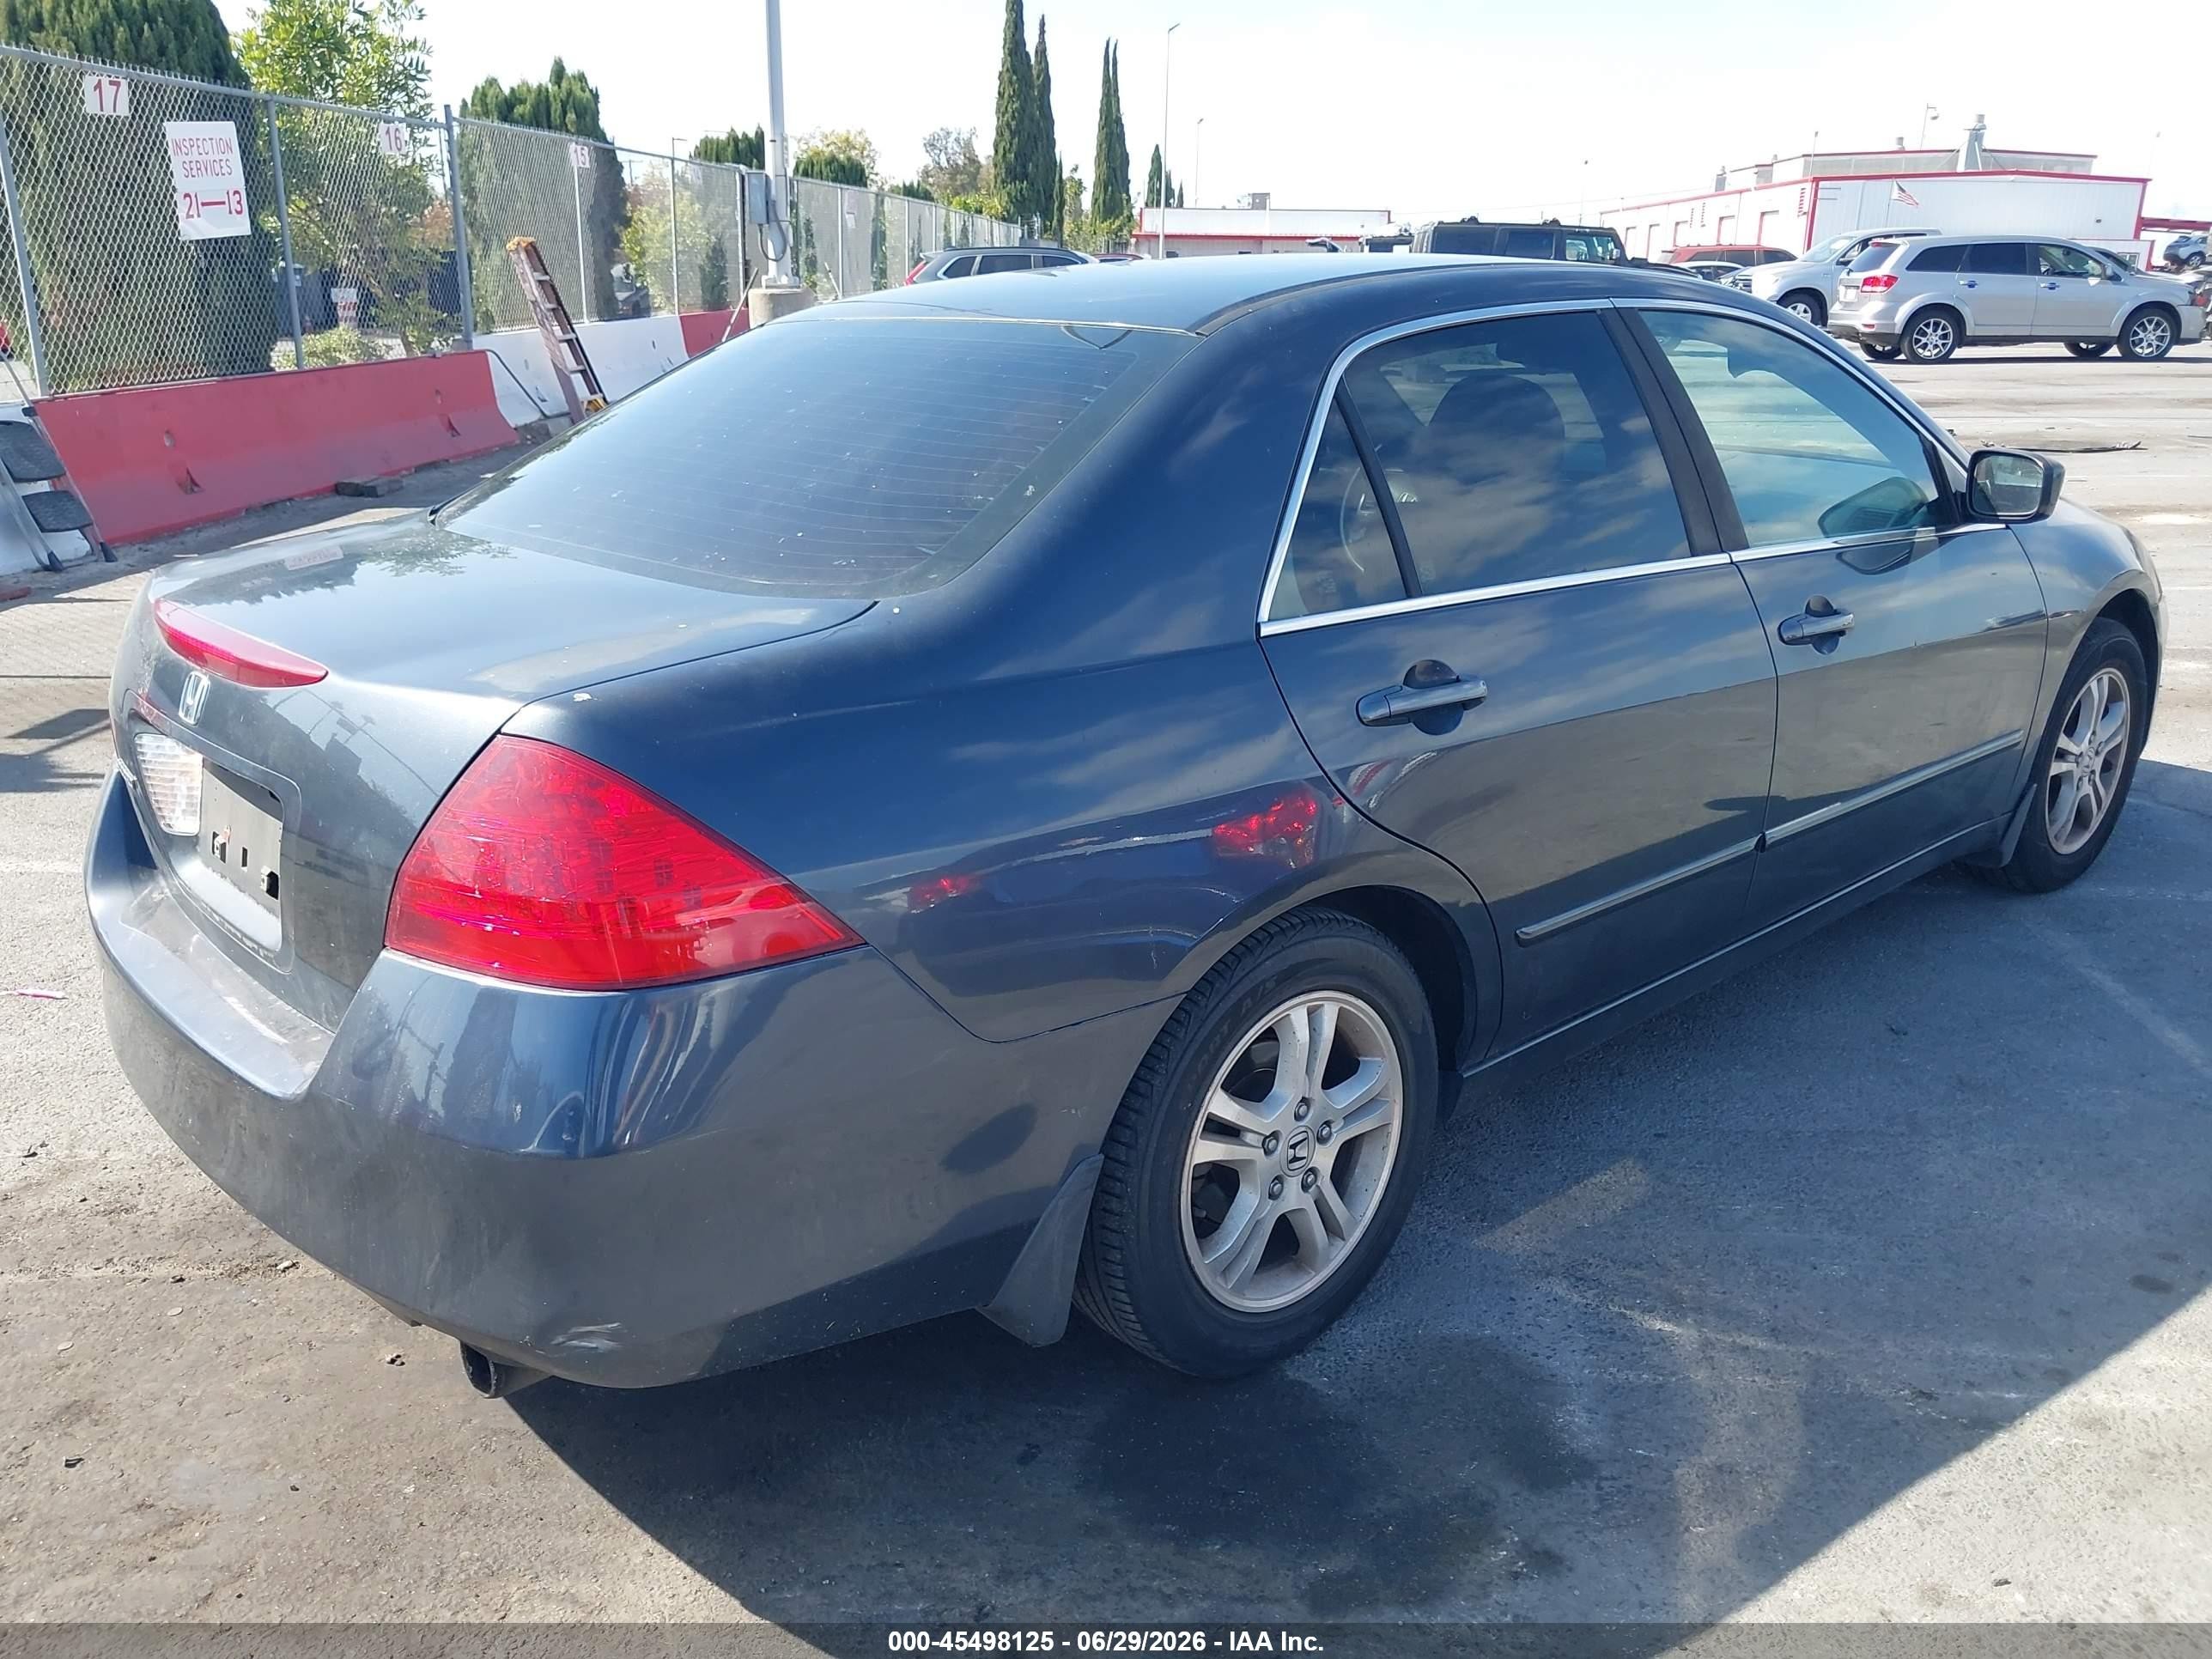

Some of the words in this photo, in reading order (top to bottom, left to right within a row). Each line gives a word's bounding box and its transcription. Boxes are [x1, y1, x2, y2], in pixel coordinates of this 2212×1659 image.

[94, 78, 121, 113] 17
[173, 137, 233, 156] INSPECTION
[386, 126, 402, 151] 16
[182, 159, 233, 179] SERVICES
